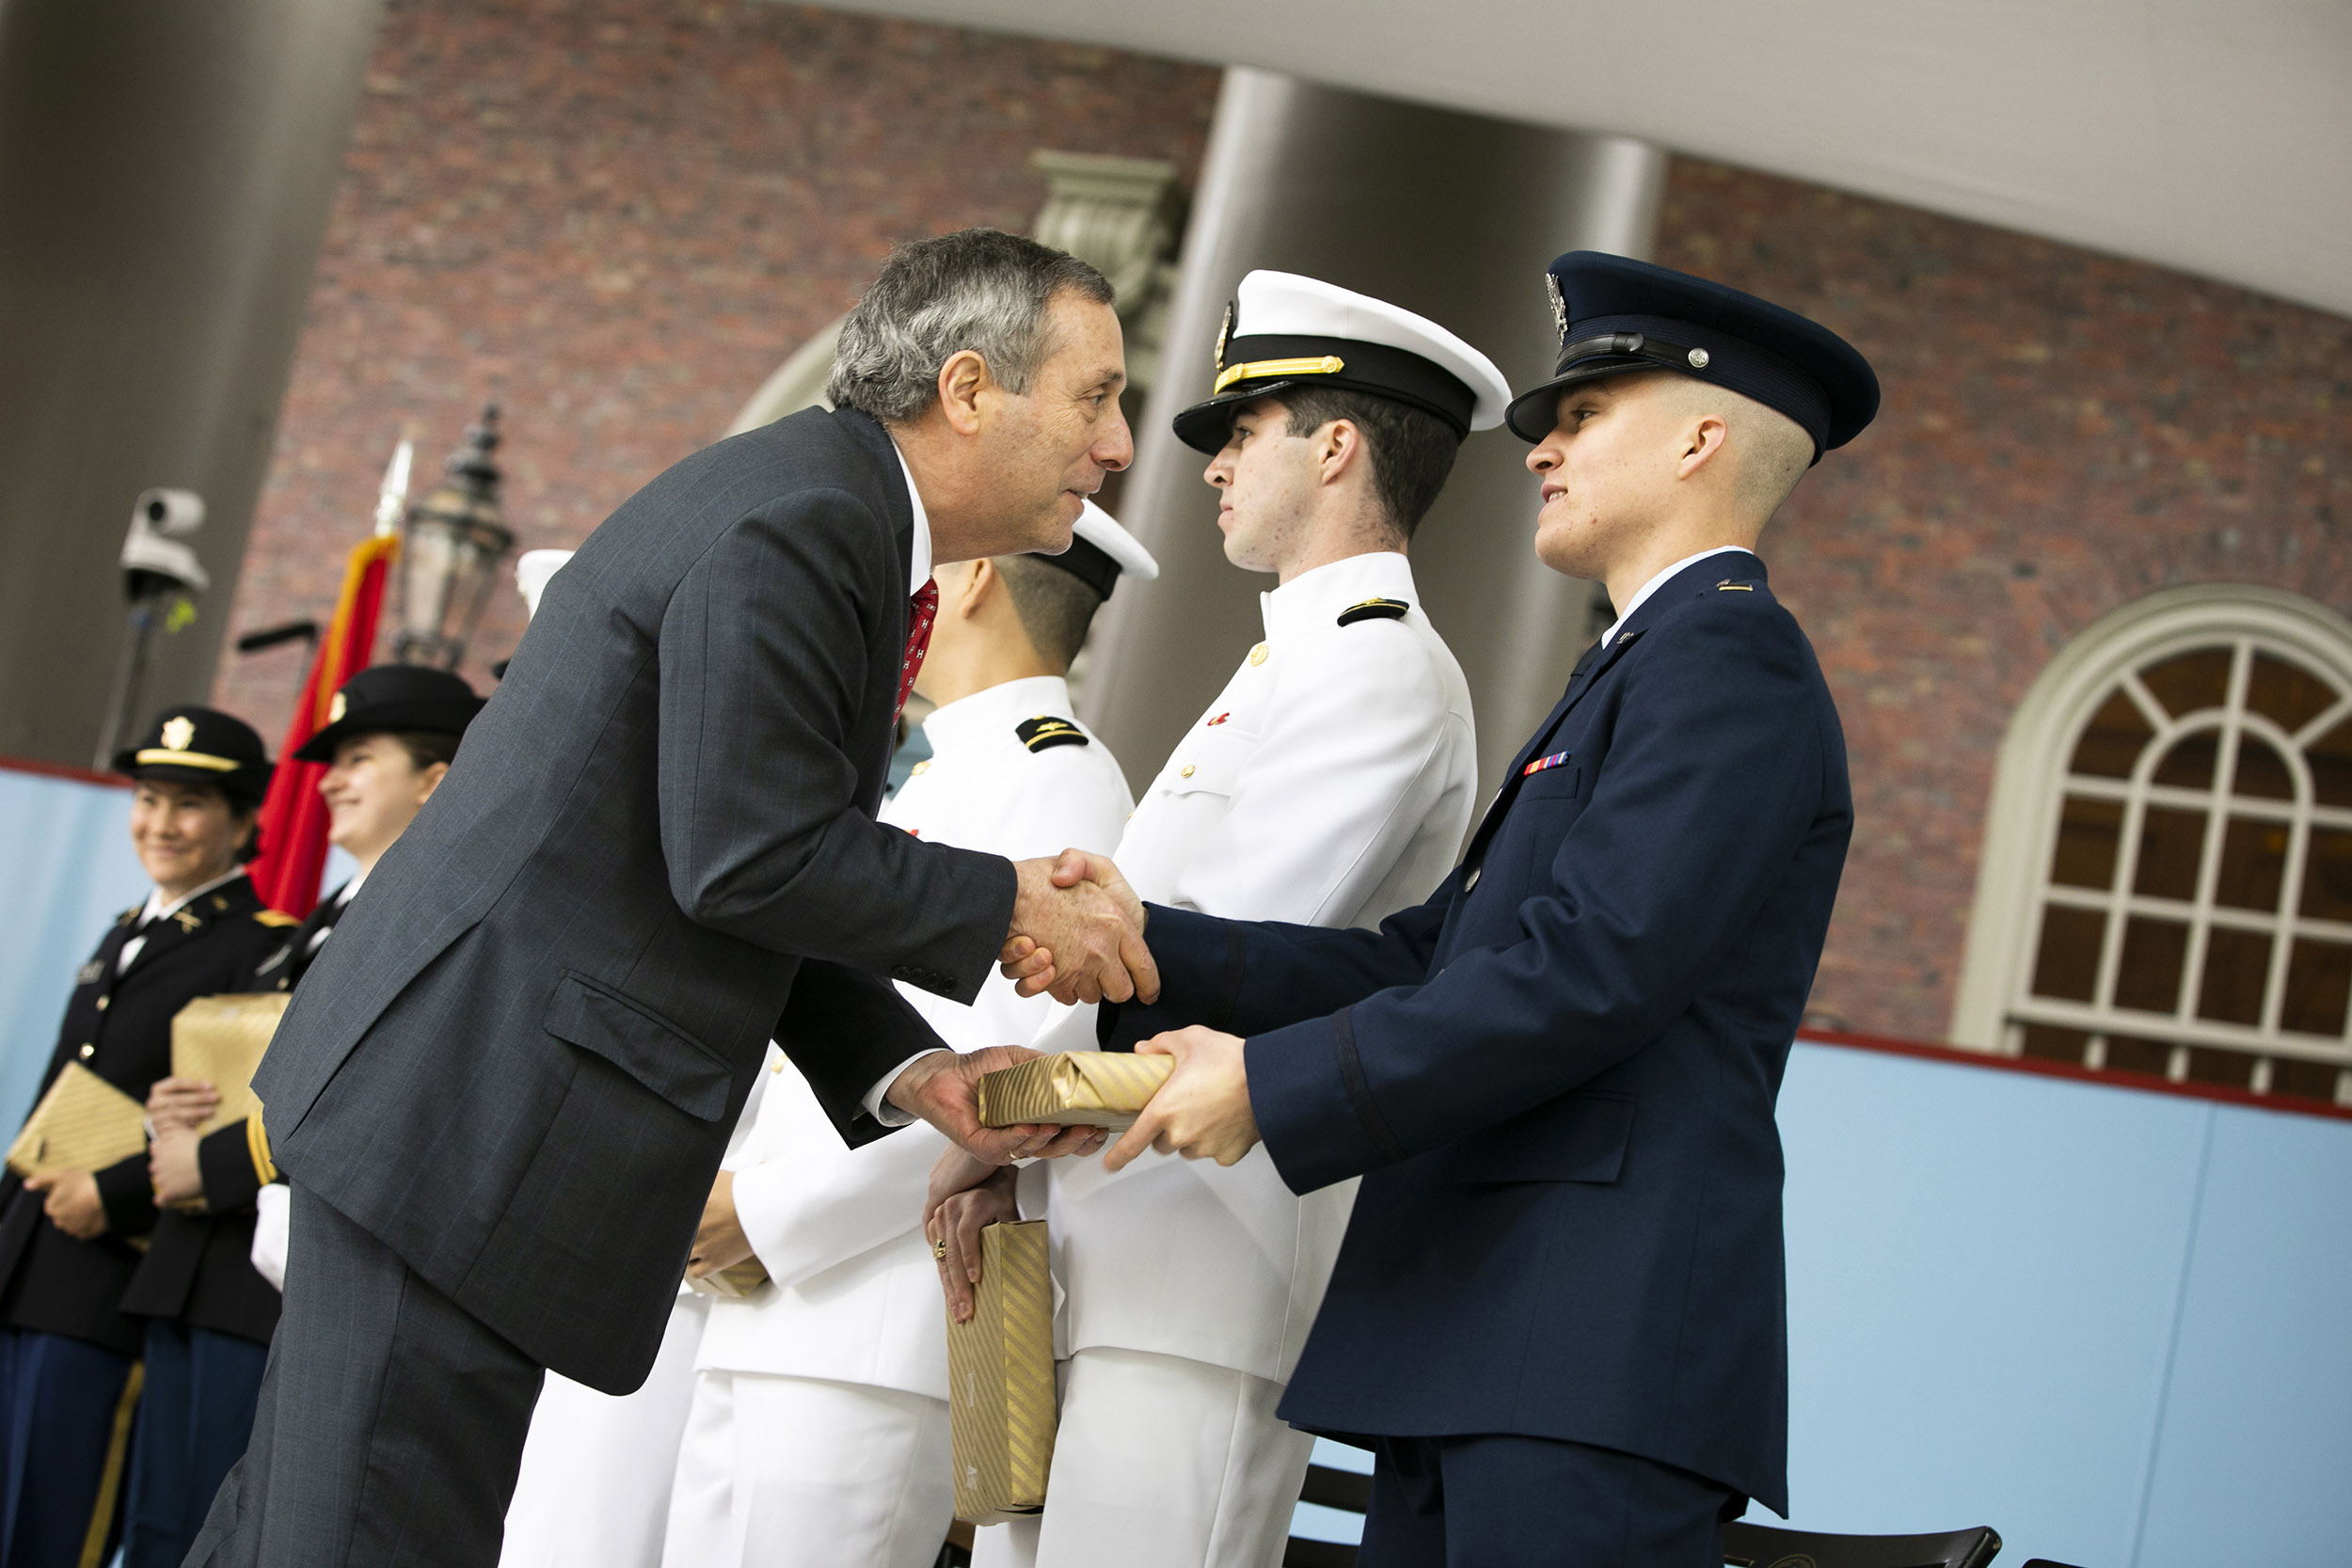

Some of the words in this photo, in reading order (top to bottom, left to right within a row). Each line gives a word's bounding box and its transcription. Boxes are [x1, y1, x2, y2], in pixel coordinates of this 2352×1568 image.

[921, 619, 929, 629] H
[916, 648, 925, 659] H
[907, 676, 914, 687] H
